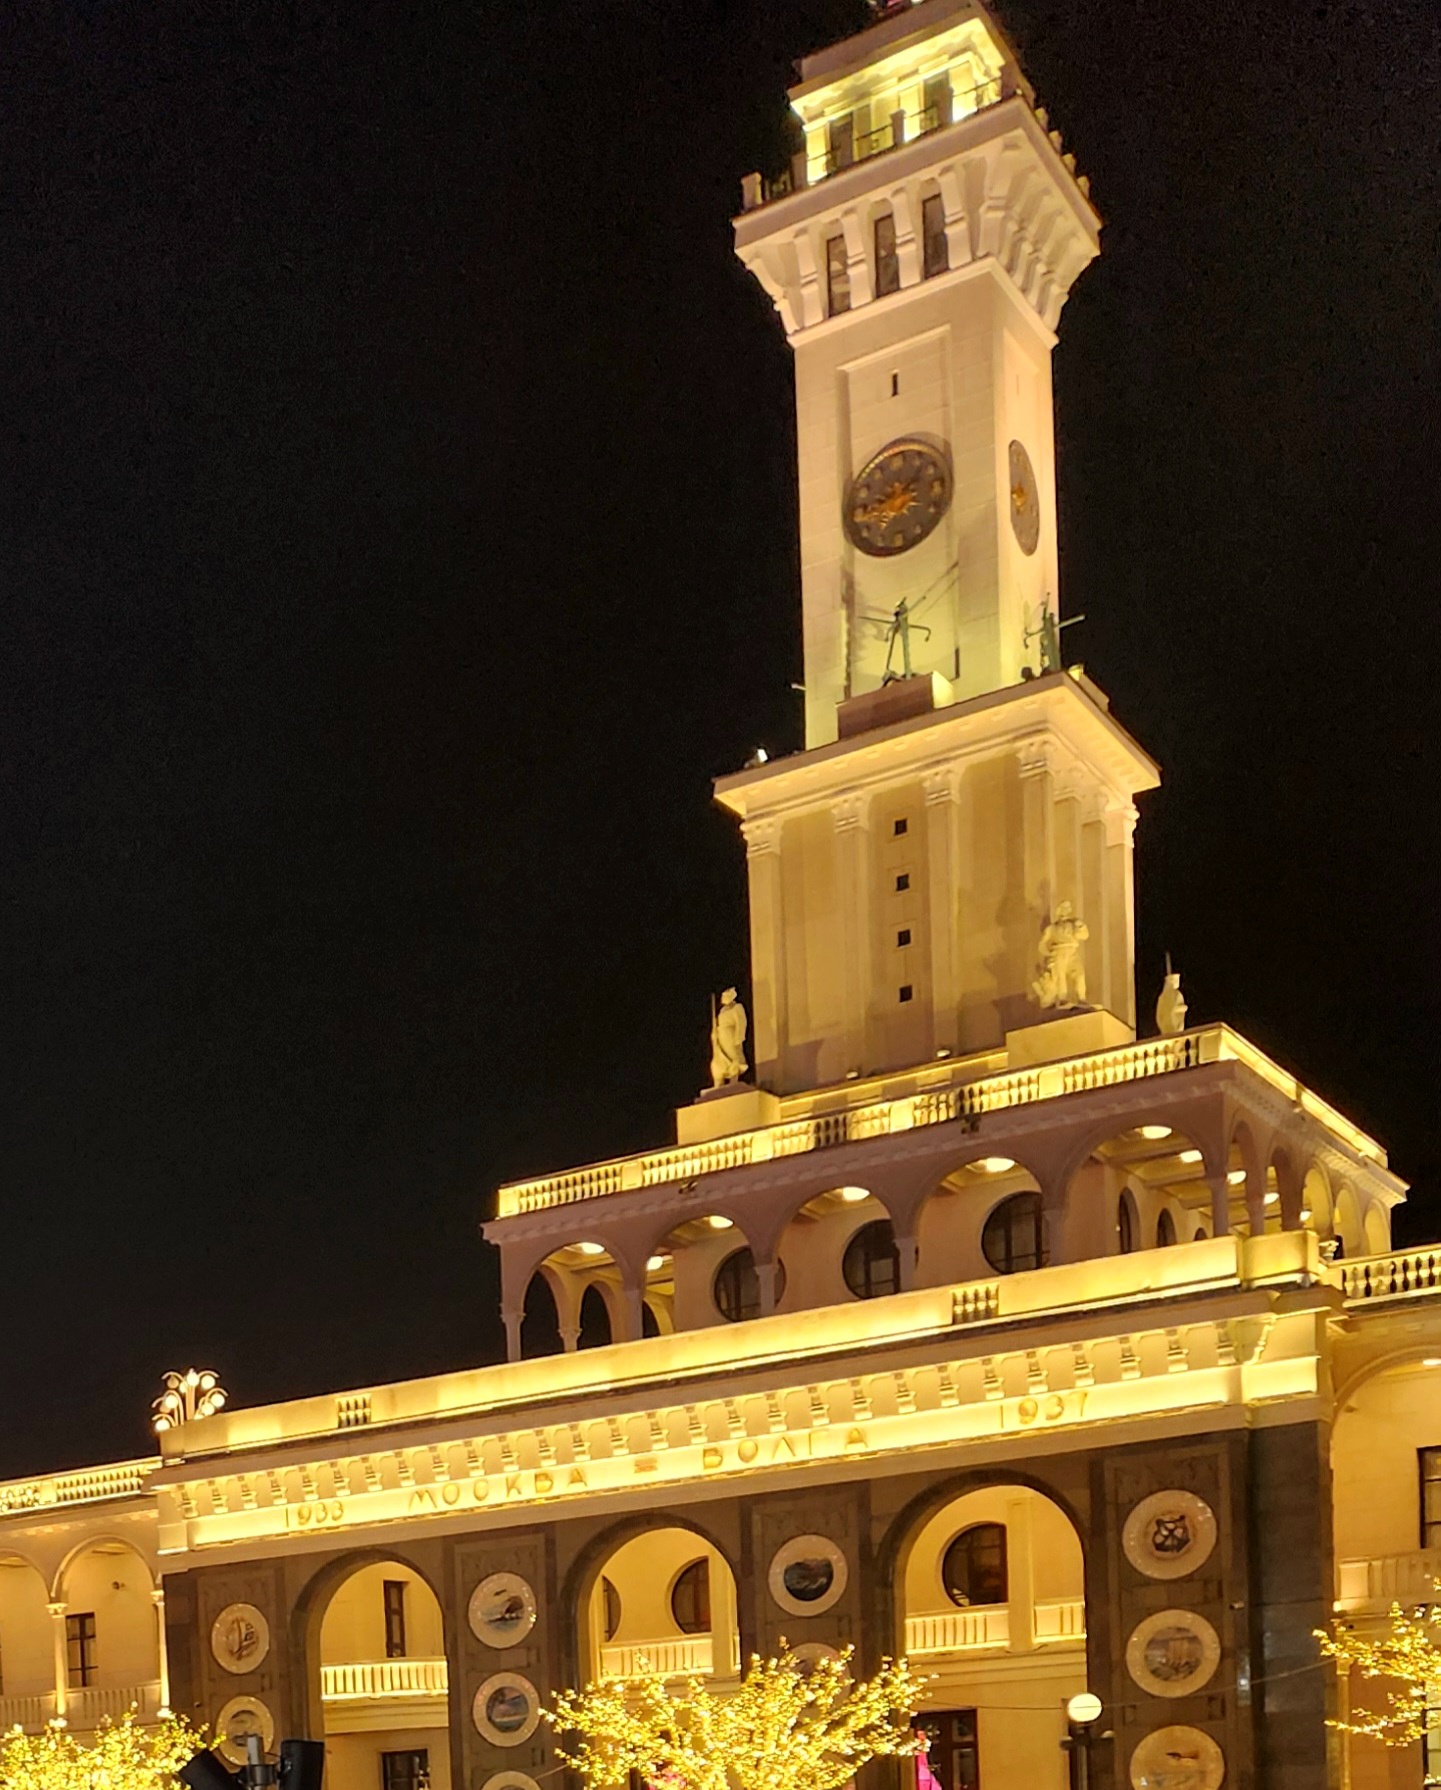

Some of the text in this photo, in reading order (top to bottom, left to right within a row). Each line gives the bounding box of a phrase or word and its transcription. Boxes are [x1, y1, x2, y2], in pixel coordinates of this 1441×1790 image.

[285, 1391, 1089, 1528] 1933 МОСКВА ВОЛГА 1937
